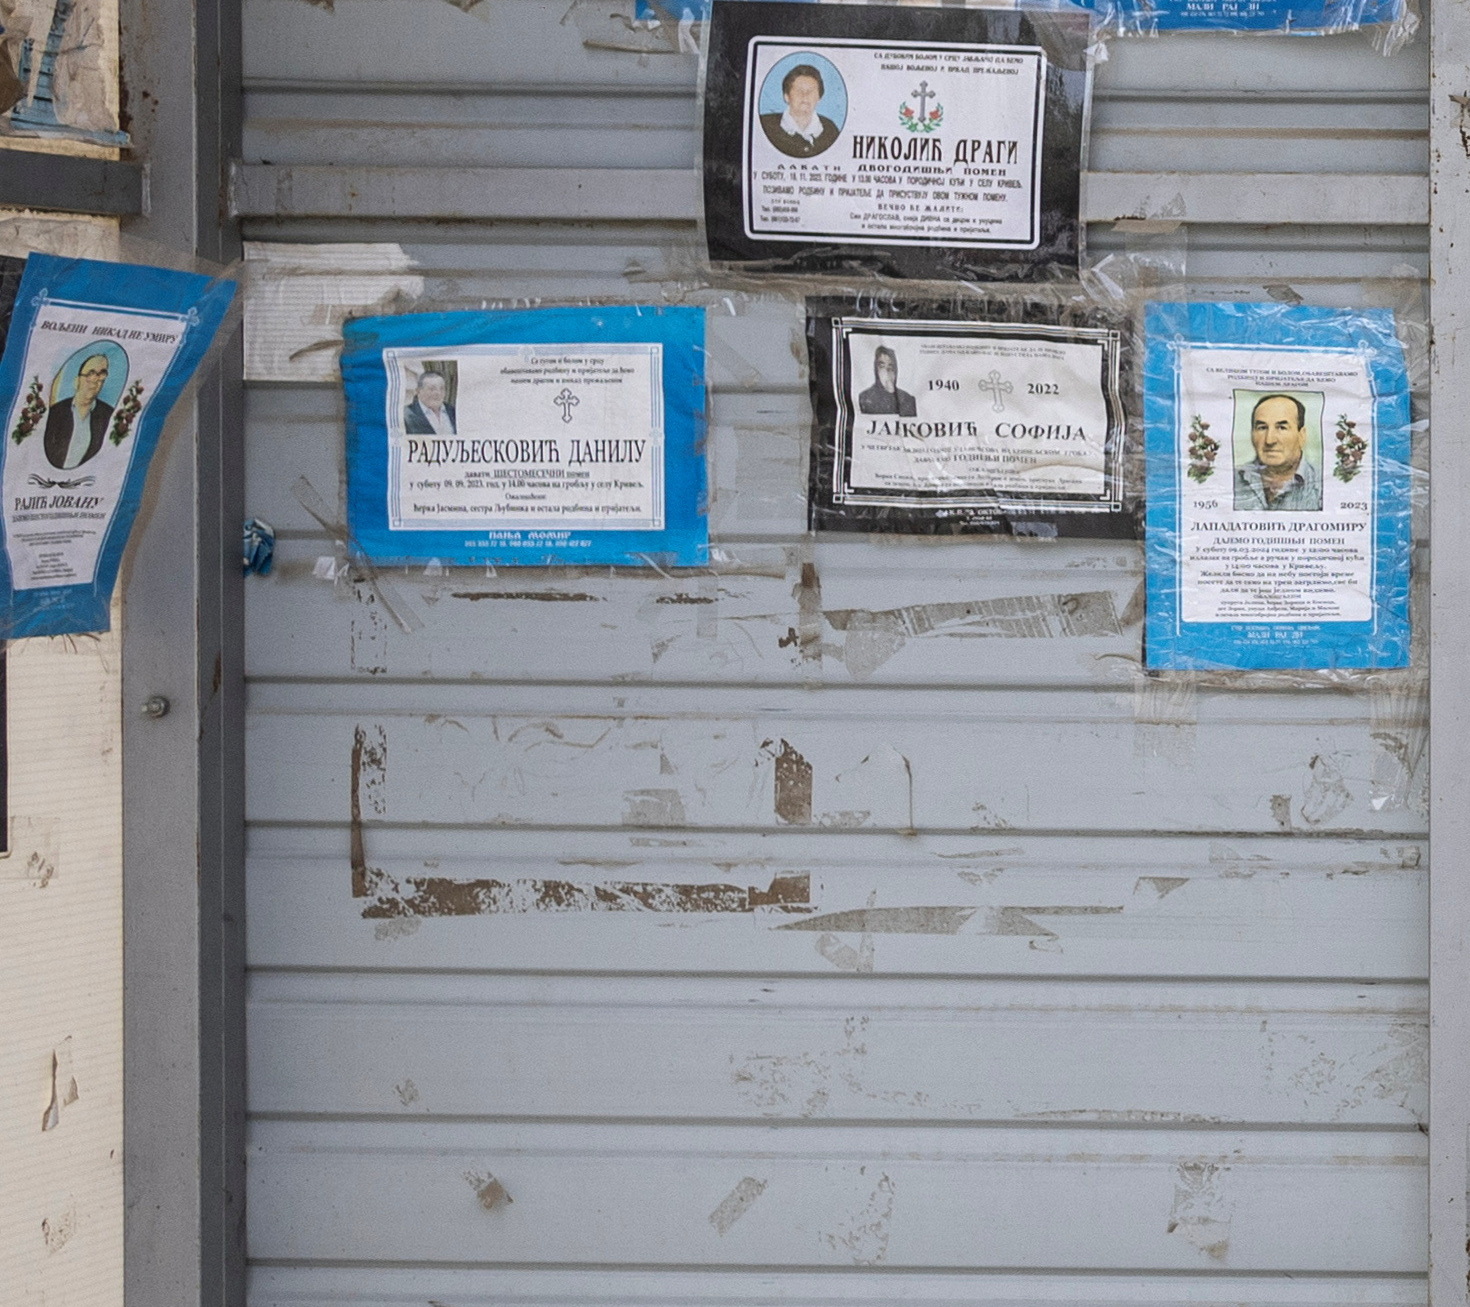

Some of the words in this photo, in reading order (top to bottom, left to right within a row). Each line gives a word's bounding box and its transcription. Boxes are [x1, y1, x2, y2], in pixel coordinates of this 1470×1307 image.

[852, 135, 942, 161] НИКОЛИЋ
[954, 140, 1018, 165] ДРАГИ
[996, 422, 1086, 440] СОФИЈА
[407, 439, 560, 466] РАДУЉЕСКОВИЋ
[569, 439, 646, 466] ДАНИЛУ
[1191, 522, 1286, 532] ЛАПАДАТОВИЋ
[1288, 522, 1367, 533] ДРАГОМИРУ
